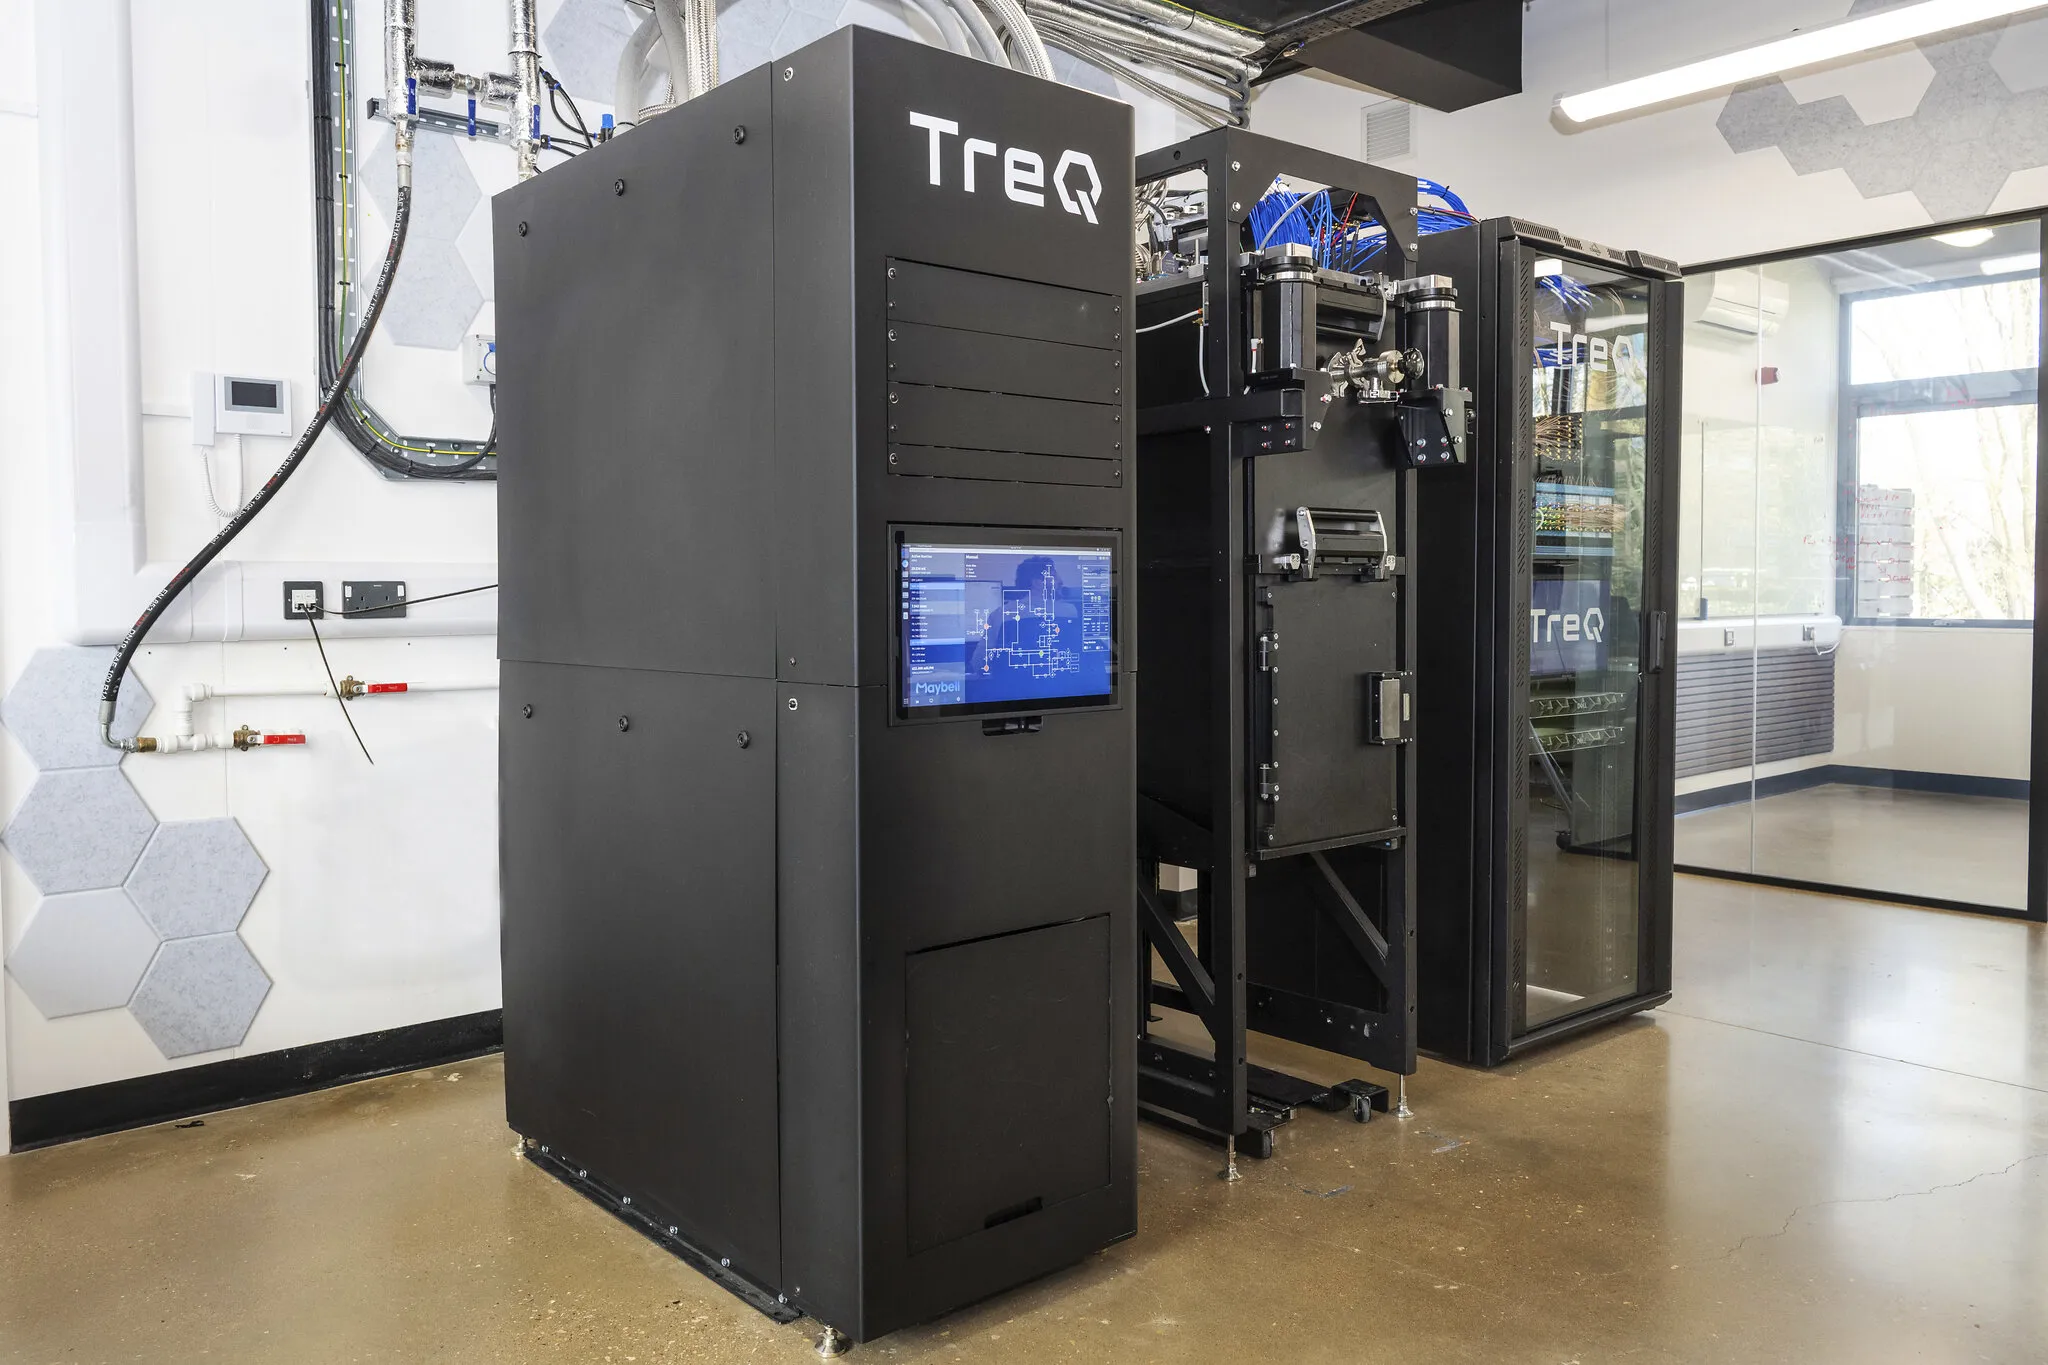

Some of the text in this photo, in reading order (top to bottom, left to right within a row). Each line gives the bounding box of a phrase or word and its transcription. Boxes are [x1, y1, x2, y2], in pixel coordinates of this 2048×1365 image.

[909, 111, 1102, 224] TreQ
[1550, 321, 1636, 378] TreQ
[1531, 607, 1604, 643] TreQ
[915, 680, 960, 695] Maybell
